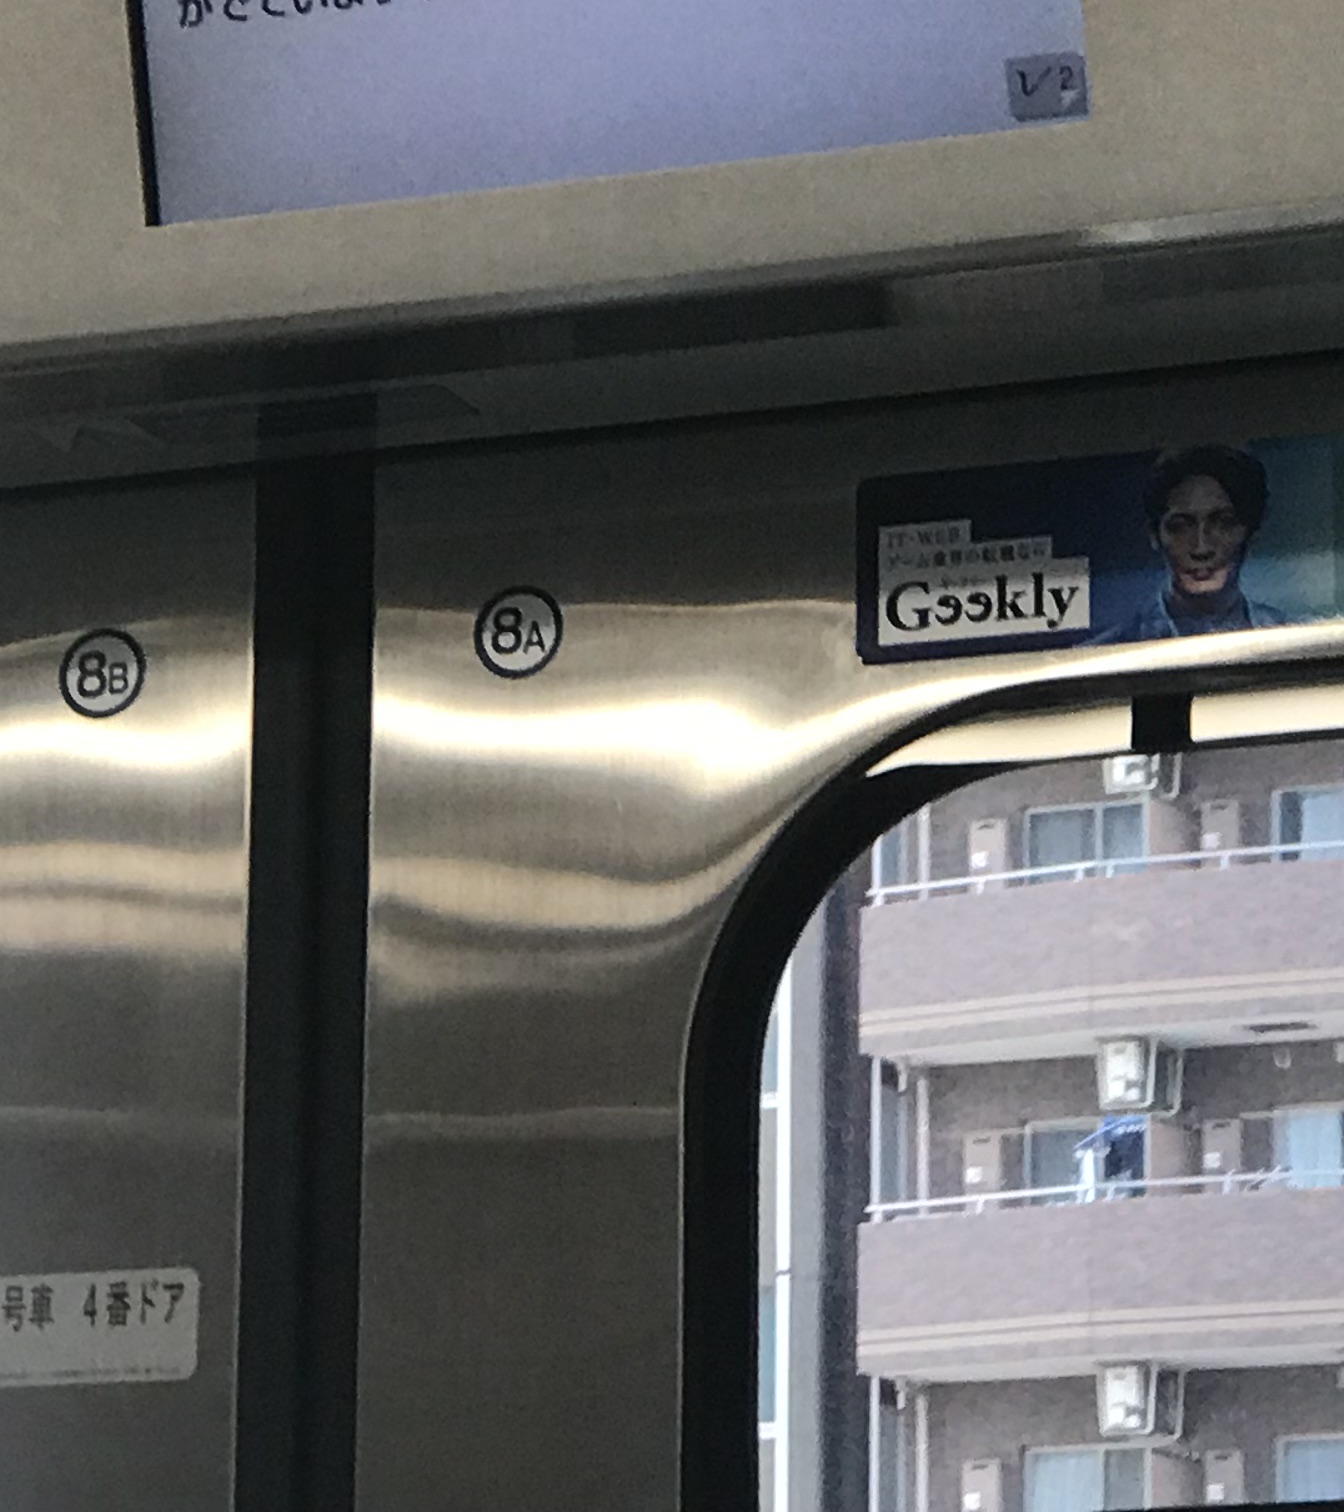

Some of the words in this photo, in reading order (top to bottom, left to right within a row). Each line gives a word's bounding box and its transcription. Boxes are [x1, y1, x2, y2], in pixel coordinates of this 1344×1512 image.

[490, 605, 546, 656] 8A
[76, 649, 130, 699] 8B
[82, 1279, 186, 1328] 4番ドア
